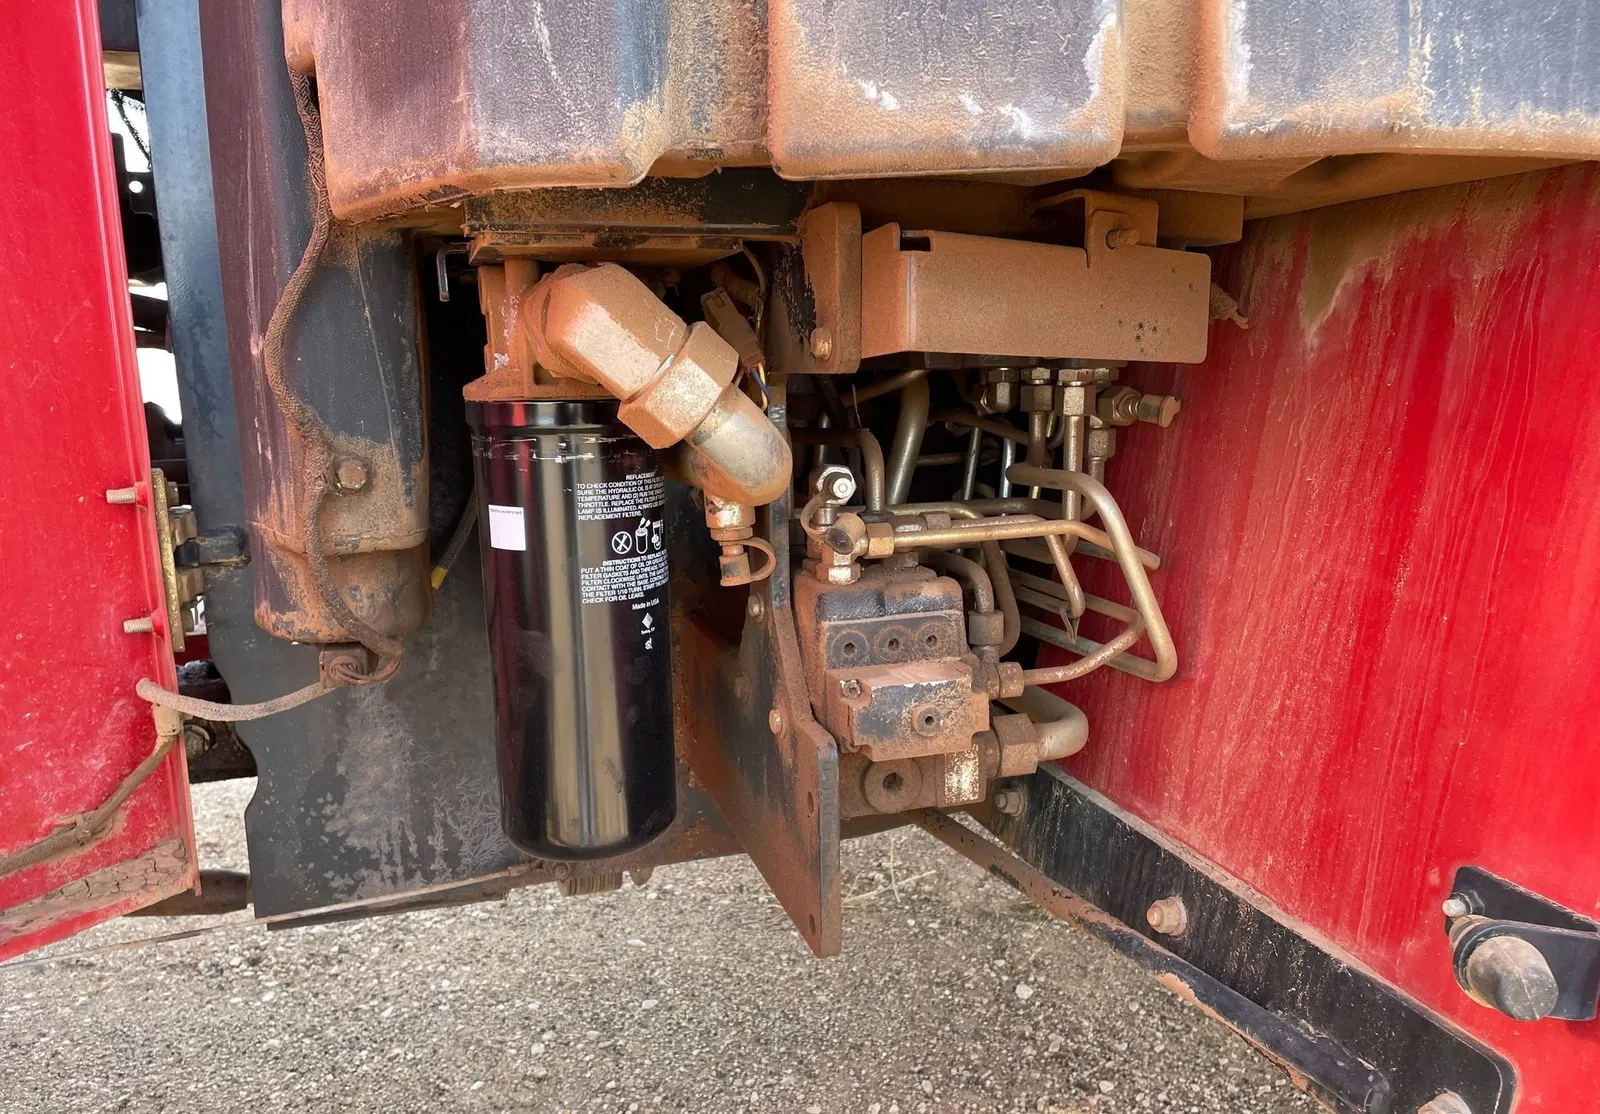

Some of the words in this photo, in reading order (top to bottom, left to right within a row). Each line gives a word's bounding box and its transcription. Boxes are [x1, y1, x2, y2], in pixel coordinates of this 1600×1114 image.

[608, 480, 637, 488] CONDITION
[608, 486, 637, 495] HYDRAULIC
[611, 499, 635, 507] REPLACE
[603, 558, 640, 566] INSTRUCTIONS
[603, 570, 629, 578] GASKETS
[603, 575, 635, 585] CLOCKWISE
[611, 582, 625, 590] WITH
[596, 589, 616, 597] FILTER
[651, 598, 659, 606] USA
